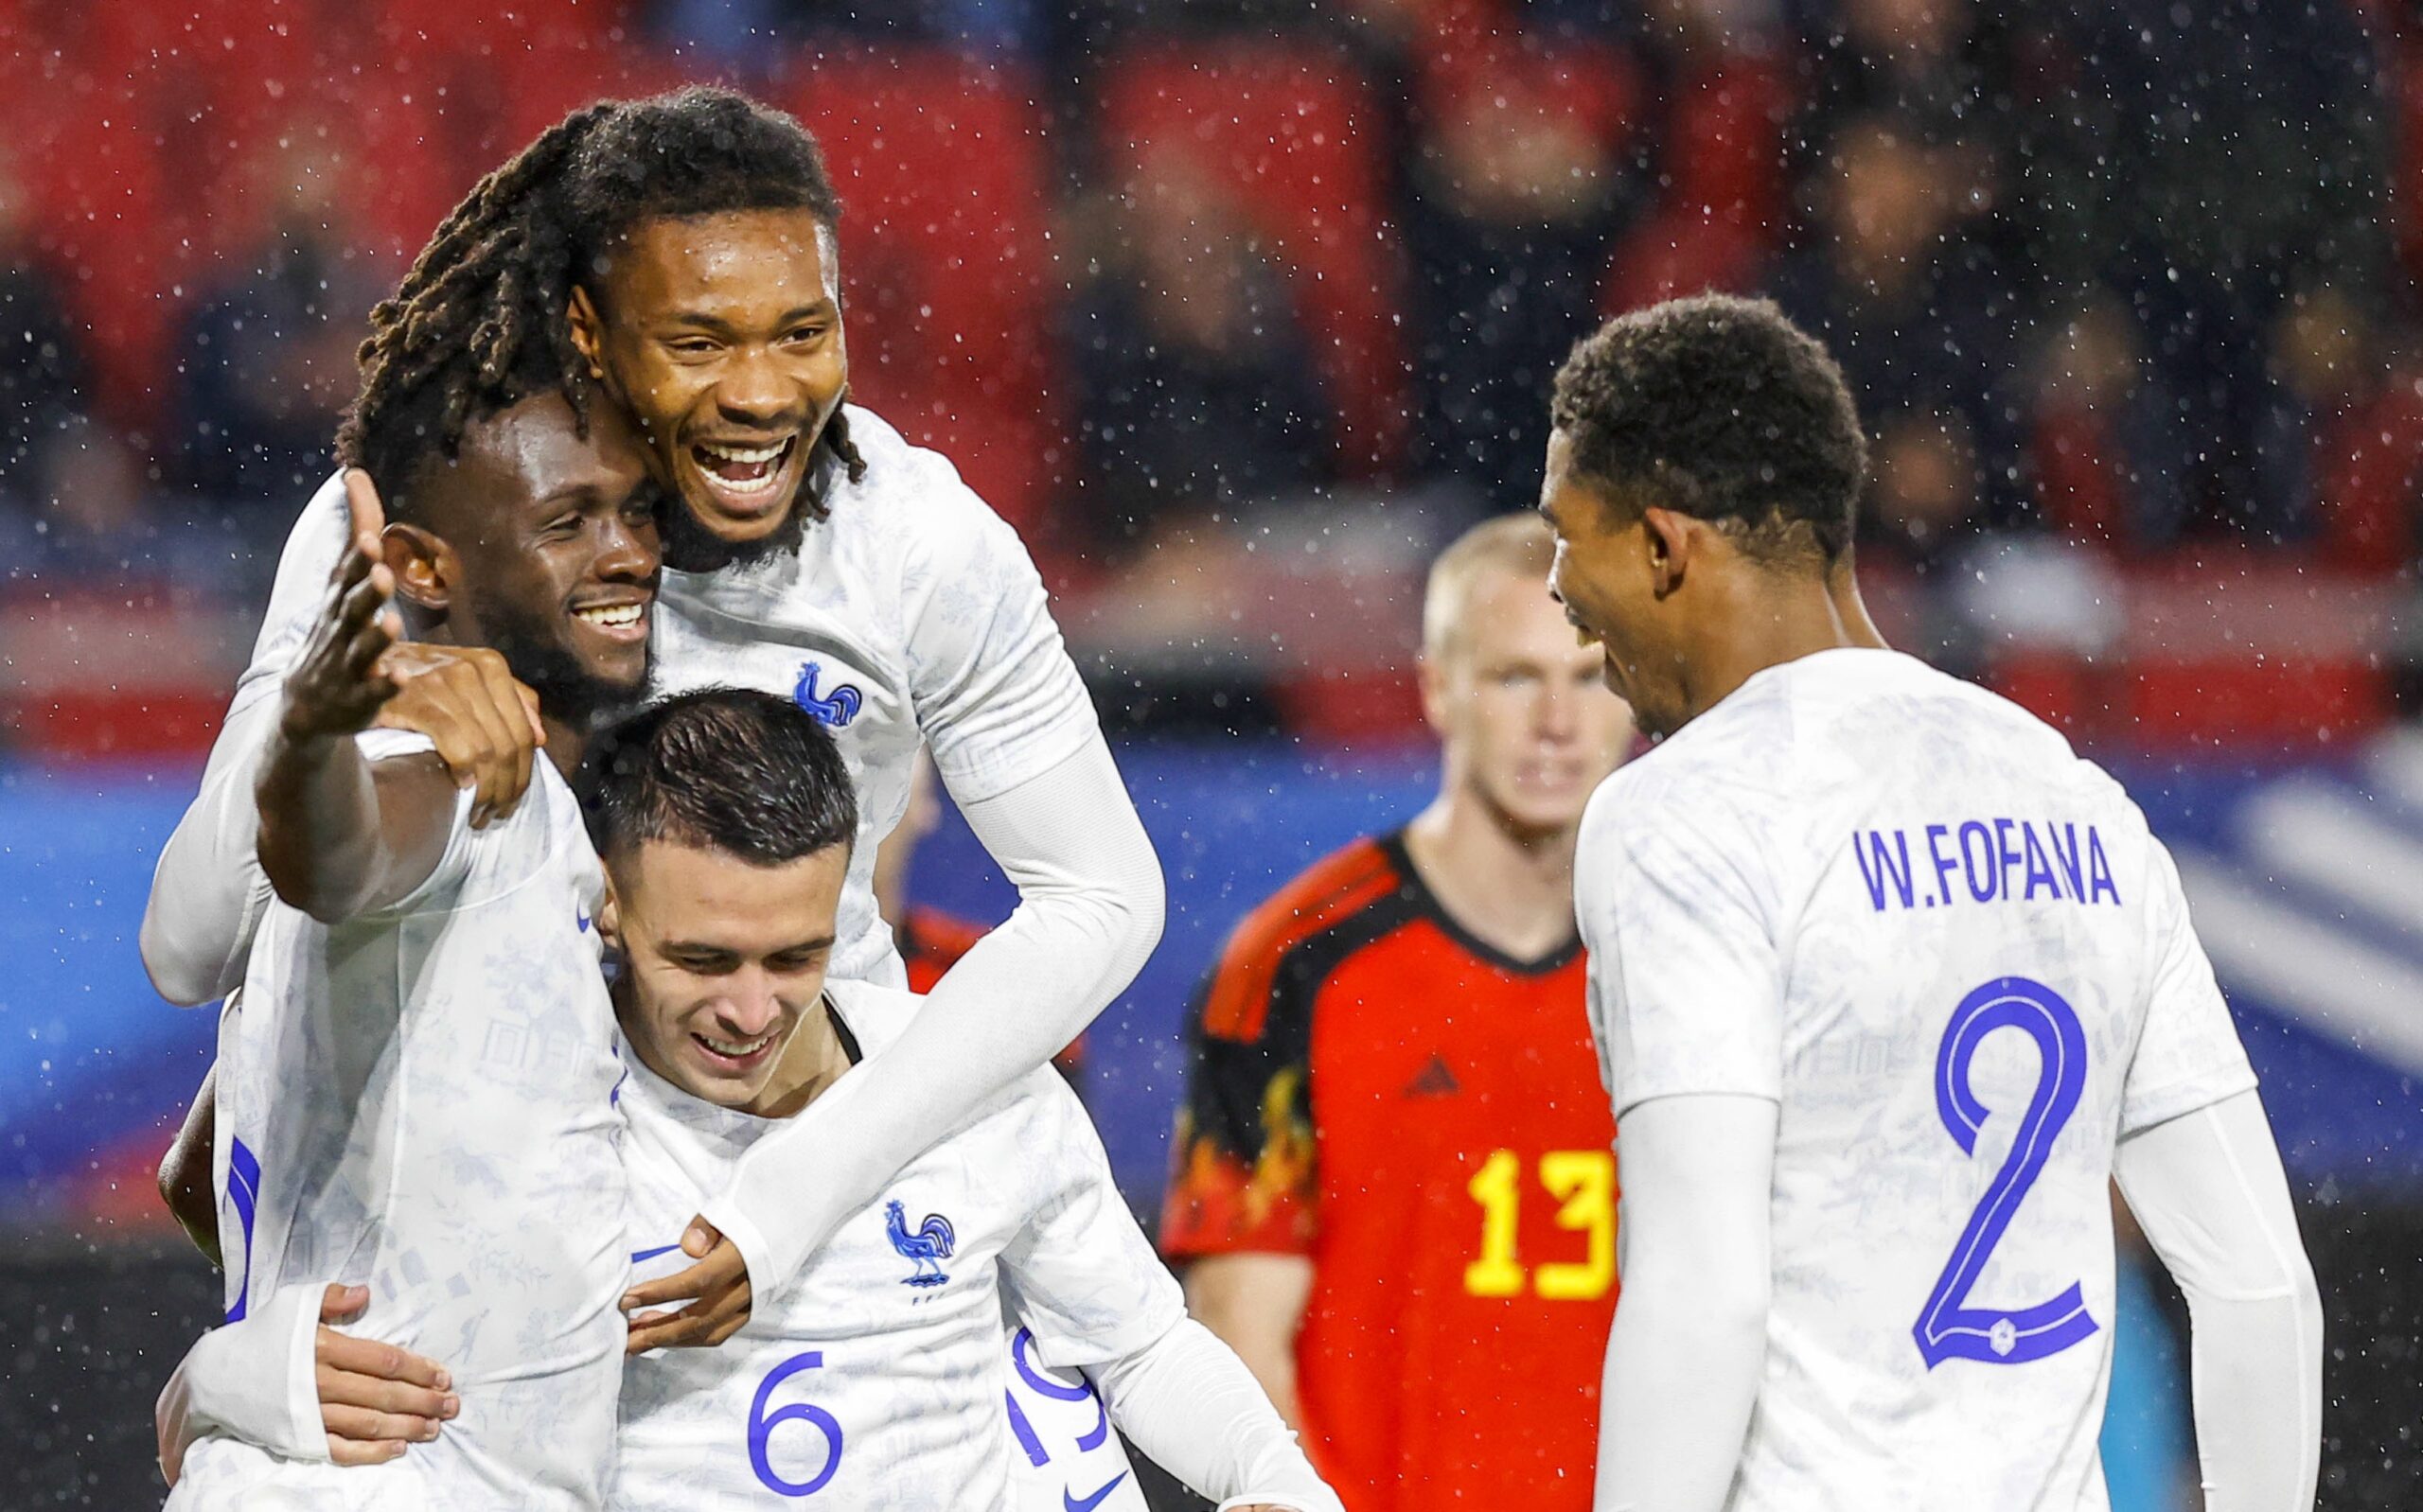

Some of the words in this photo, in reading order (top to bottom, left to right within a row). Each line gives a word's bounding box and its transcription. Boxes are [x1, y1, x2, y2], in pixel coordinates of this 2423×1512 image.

[1852, 817, 2122, 912] W.FOFANA
[1464, 1148, 1616, 1301] 13
[1912, 976, 2100, 1371] 2
[747, 1350, 843, 1497] 6
